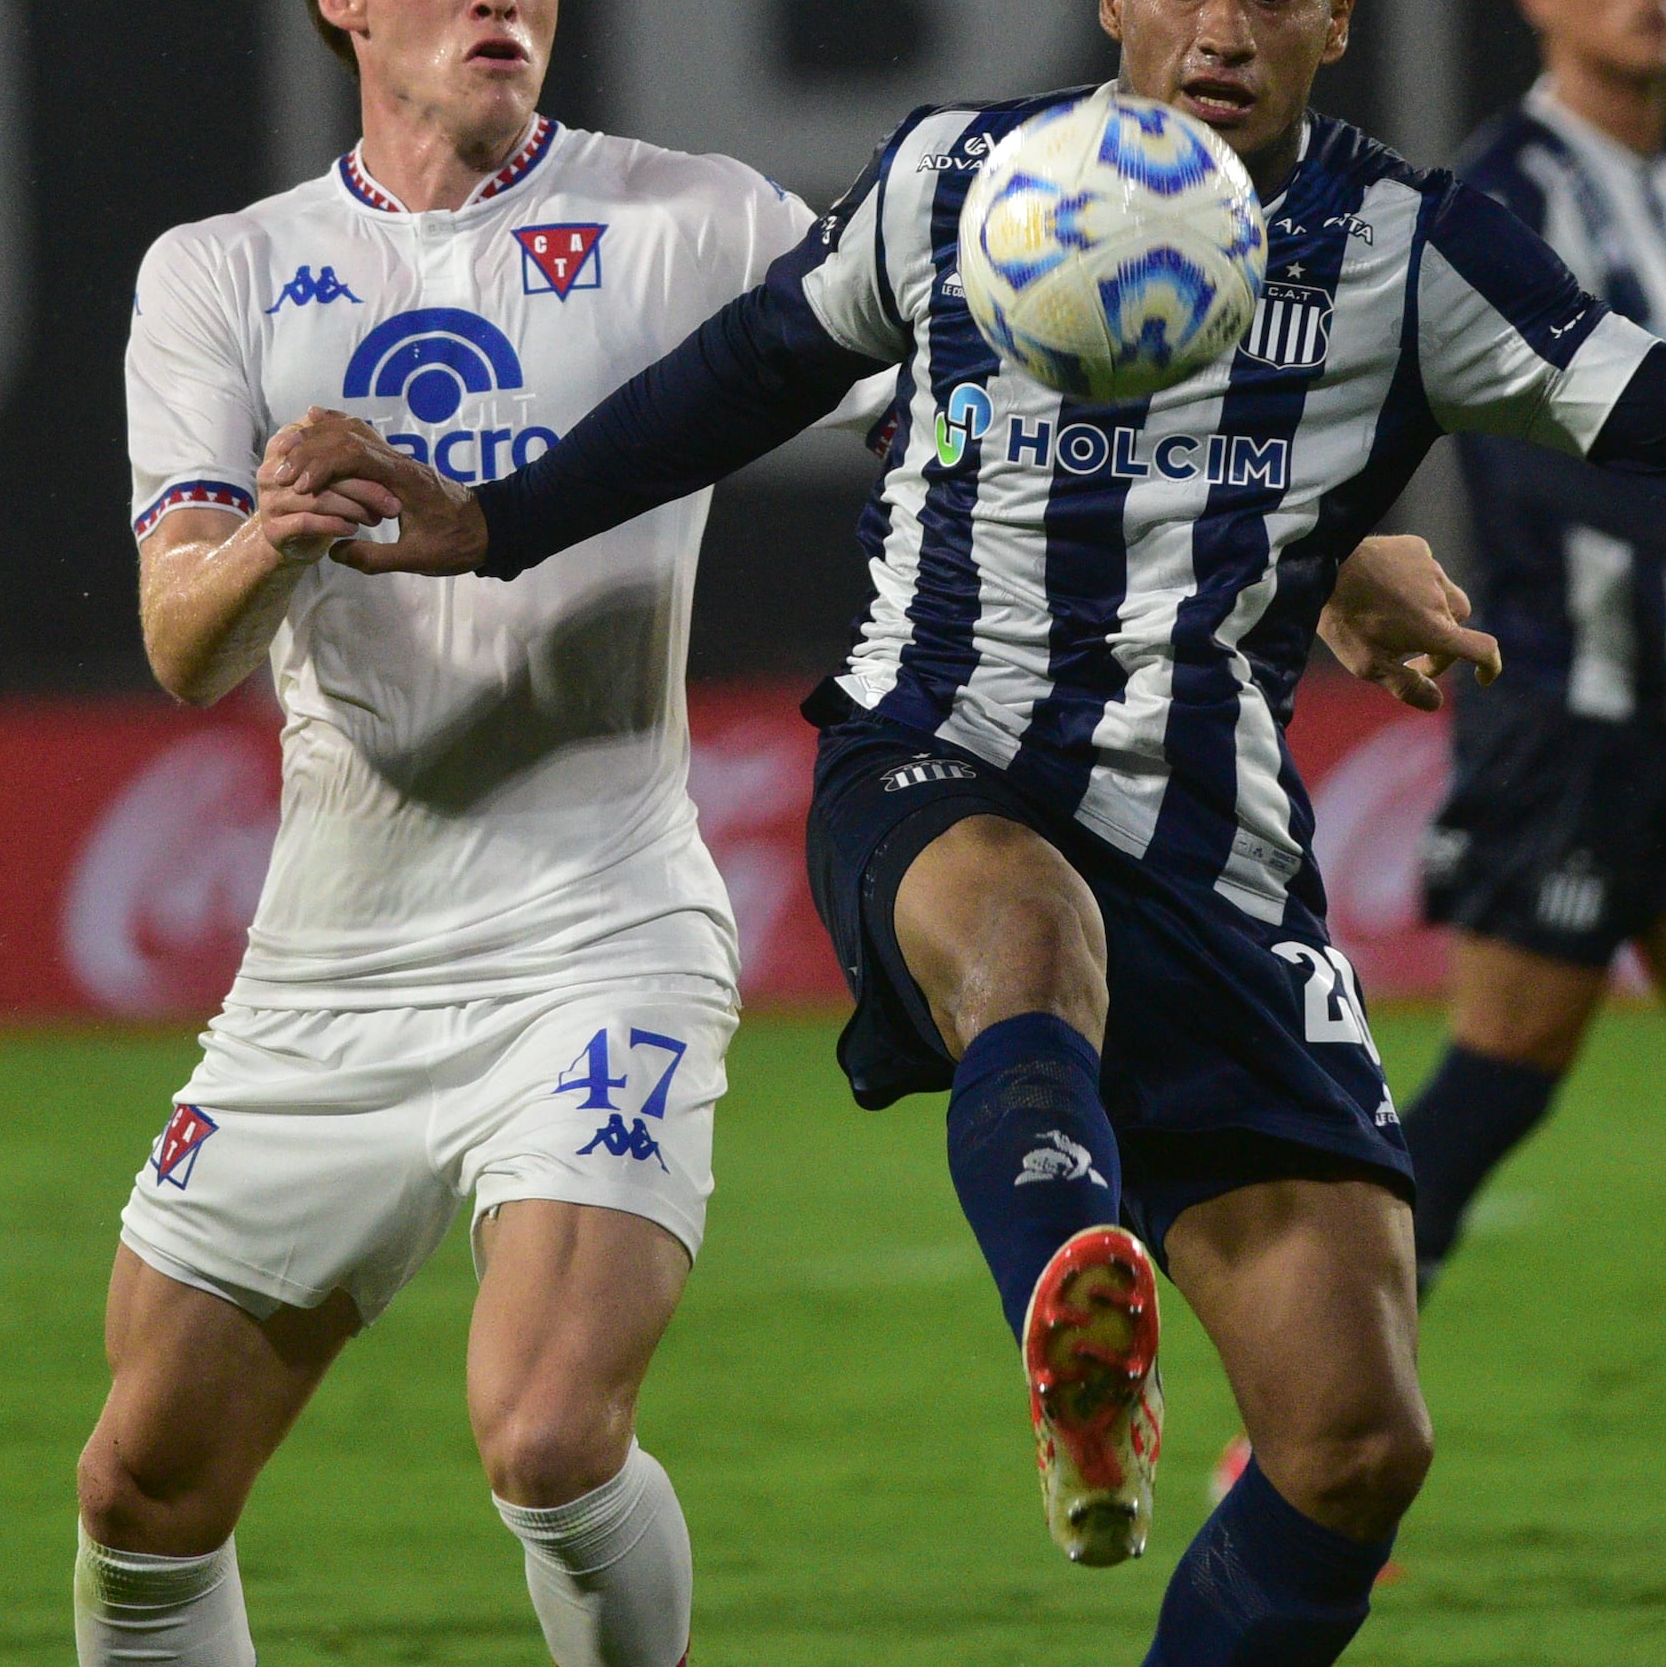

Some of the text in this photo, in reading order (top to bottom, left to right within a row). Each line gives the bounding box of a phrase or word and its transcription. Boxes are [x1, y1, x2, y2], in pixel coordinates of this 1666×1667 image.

[367, 420, 561, 483] acro
[1006, 414, 1289, 490] HOLCIM
[550, 1027, 688, 1120] 47
